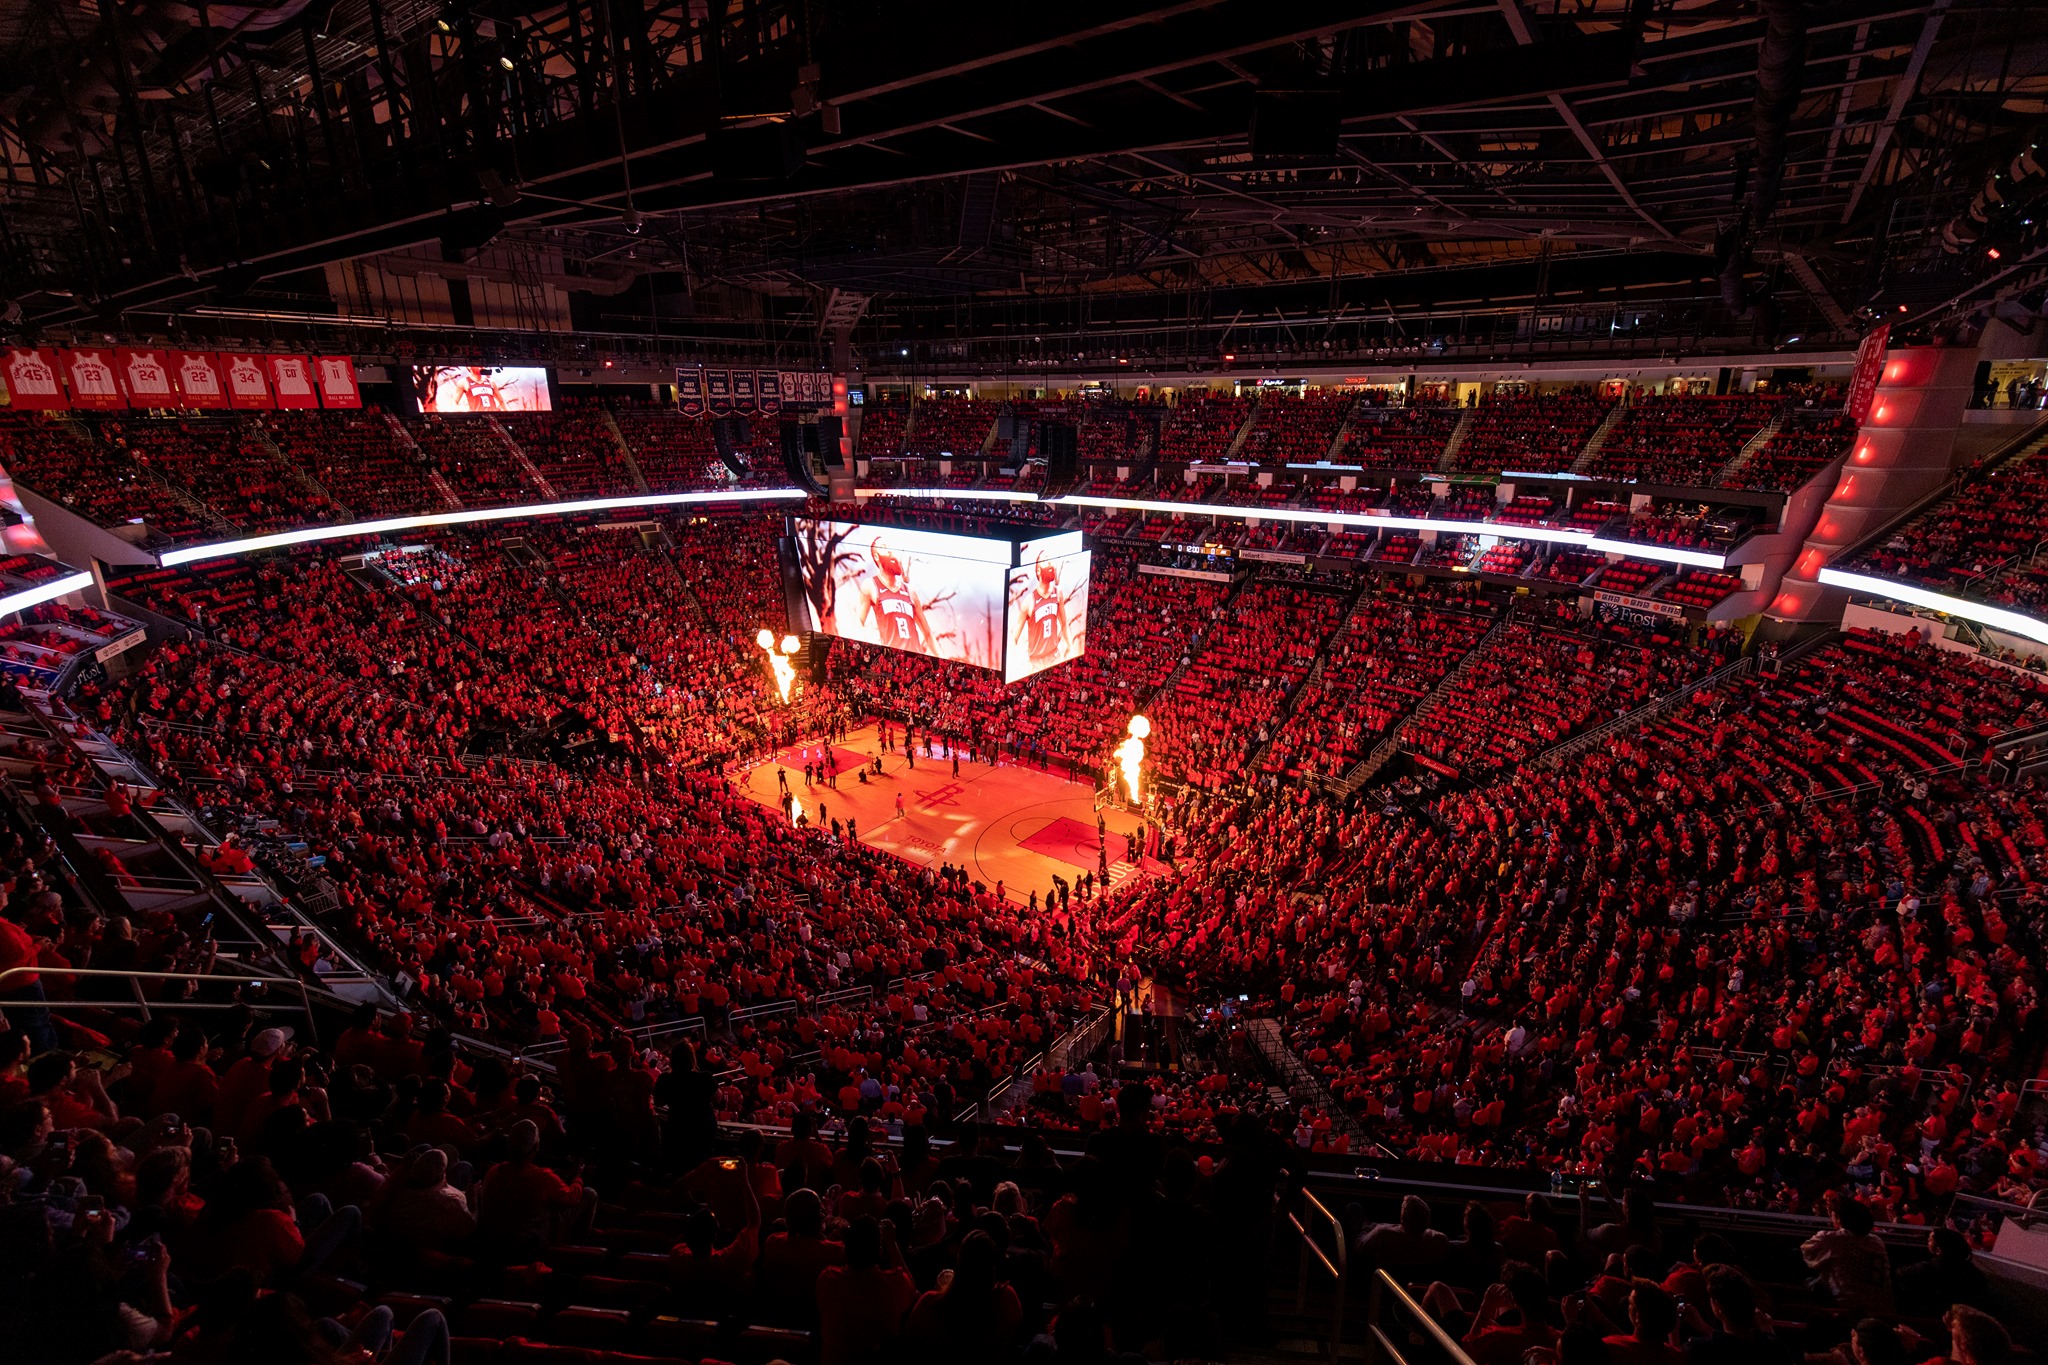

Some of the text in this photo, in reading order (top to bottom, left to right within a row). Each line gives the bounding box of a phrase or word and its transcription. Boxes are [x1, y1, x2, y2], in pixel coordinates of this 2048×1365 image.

[75, 363, 106, 371] MURPHY
[184, 365, 211, 373] DREXLER
[232, 367, 260, 375] OLAJUWON
[24, 369, 43, 381] 45
[84, 370, 101, 381] 23
[139, 370, 157, 381] 24
[191, 371, 208, 382] 22
[239, 373, 255, 383] 34
[332, 369, 340, 379] 11
[830, 502, 991, 535] TOYOTA CENTER
[1186, 545, 1200, 554] 12:00
[1620, 607, 1658, 628] Frost
[1422, 757, 1450, 775] Budweiser
[906, 835, 947, 854] TOYOTA
